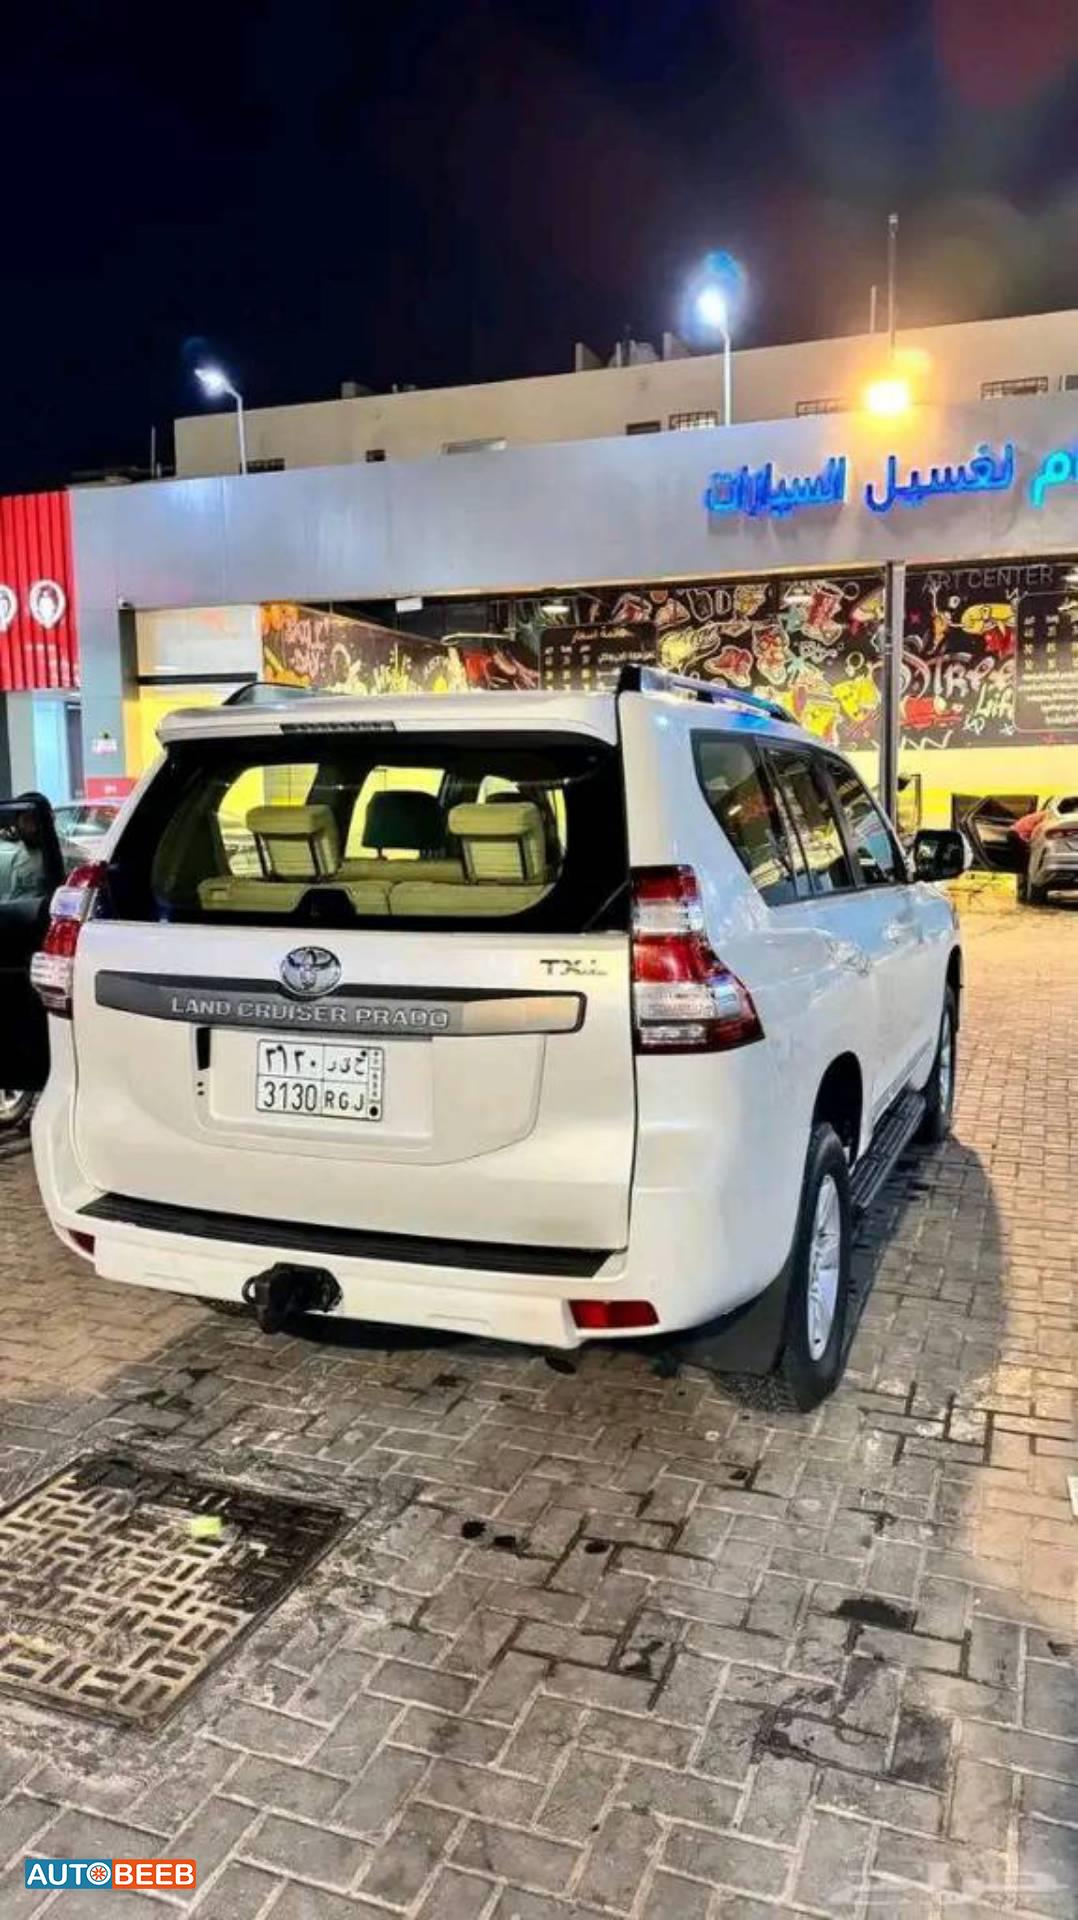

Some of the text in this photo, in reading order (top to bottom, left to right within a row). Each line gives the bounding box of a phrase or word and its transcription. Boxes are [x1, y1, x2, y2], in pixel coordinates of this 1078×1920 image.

[705, 454, 848, 516] السيارات
[866, 443, 1015, 513] لغسيل
[967, 565, 1054, 588] CENTER
[171, 996, 449, 1028] LAND CRUISER PRADO
[264, 1081, 317, 1111] 3130
